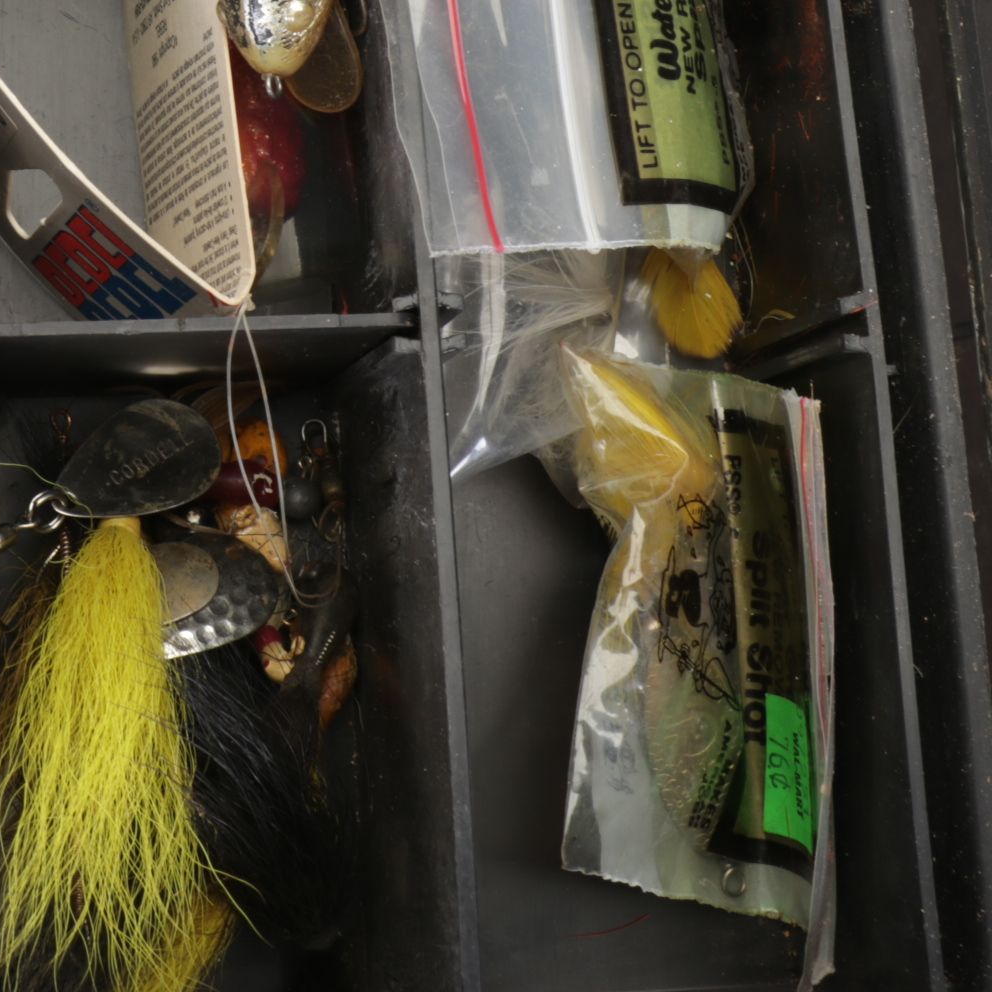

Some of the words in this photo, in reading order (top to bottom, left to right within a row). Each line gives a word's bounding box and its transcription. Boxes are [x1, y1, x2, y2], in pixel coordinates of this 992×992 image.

[615, 1, 643, 73] OPEN
[675, 30, 697, 95] NEW
[625, 74, 647, 113] TO
[634, 121, 659, 170] LIFT
[746, 529, 772, 627] Split
[743, 641, 773, 746] Shot
